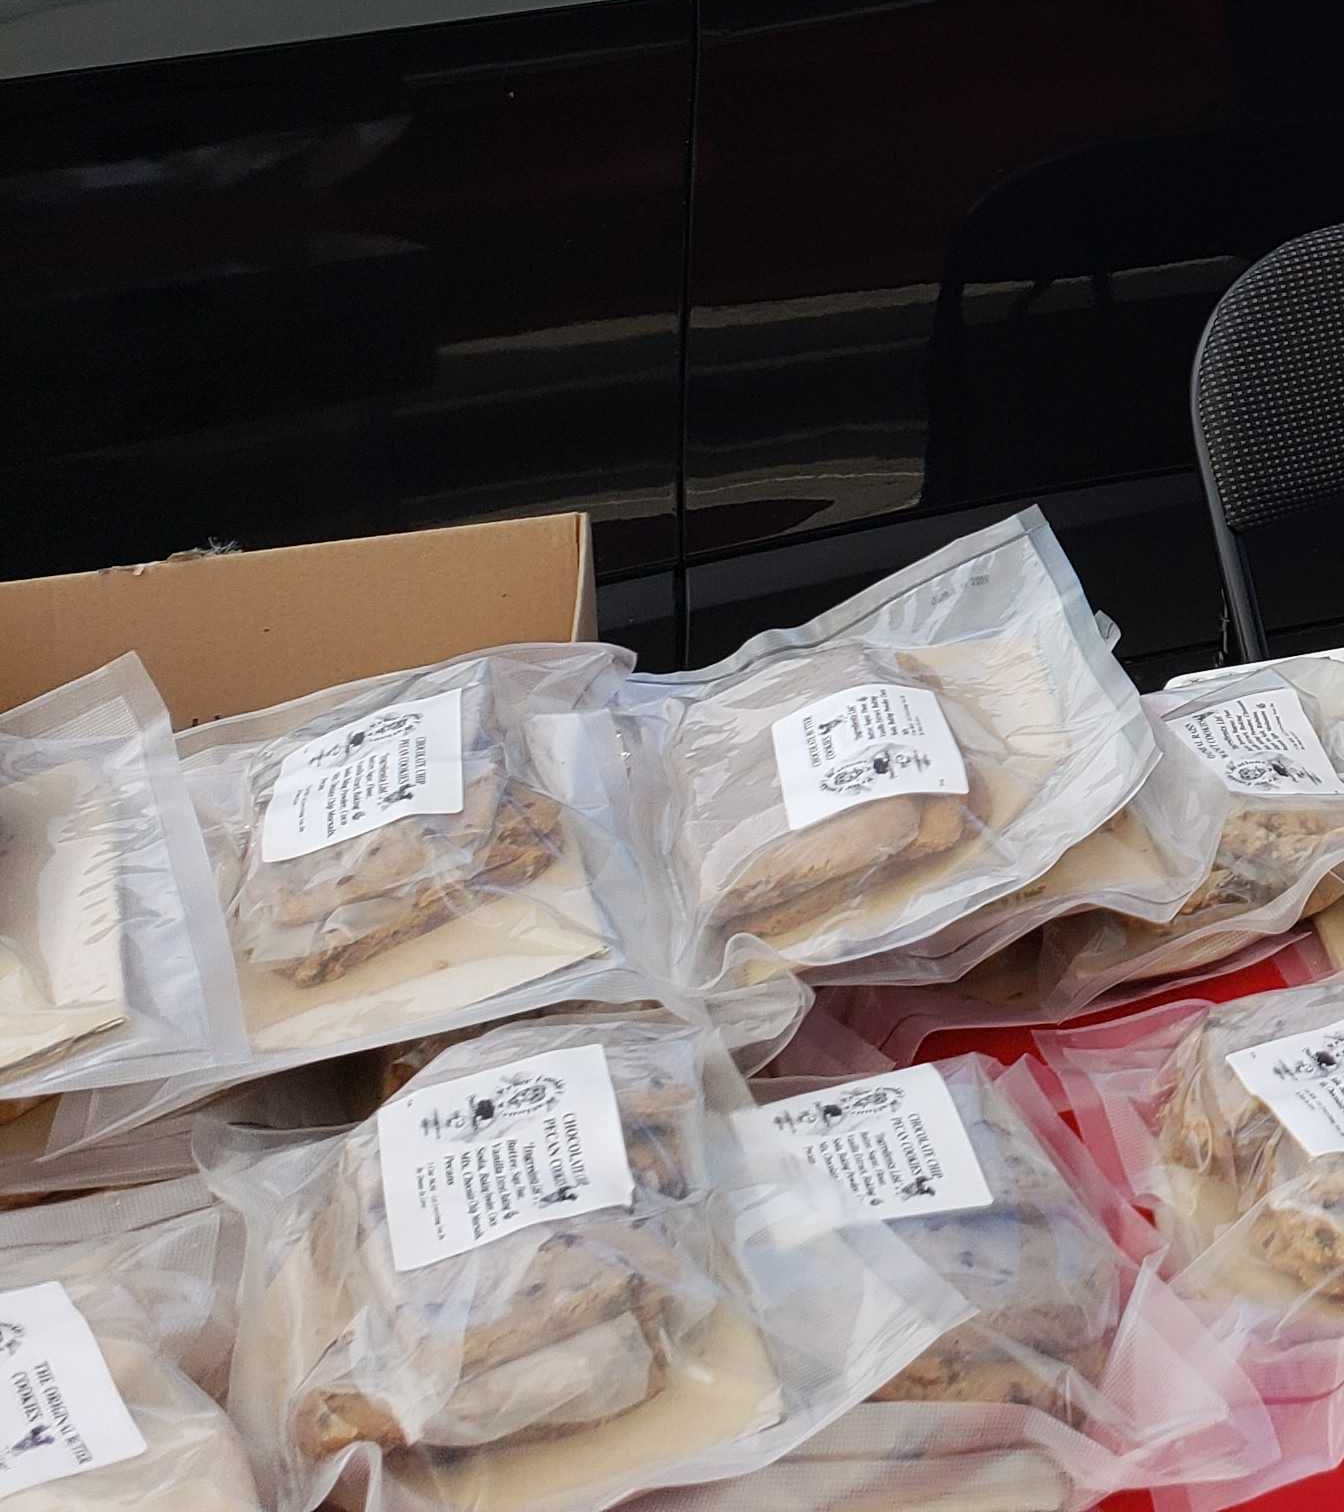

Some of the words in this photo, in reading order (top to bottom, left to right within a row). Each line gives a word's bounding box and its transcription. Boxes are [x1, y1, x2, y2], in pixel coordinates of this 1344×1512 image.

[543, 1118, 560, 1156] PECAN
[33, 1361, 54, 1386] THE
[9, 1369, 45, 1422] COOKIES
